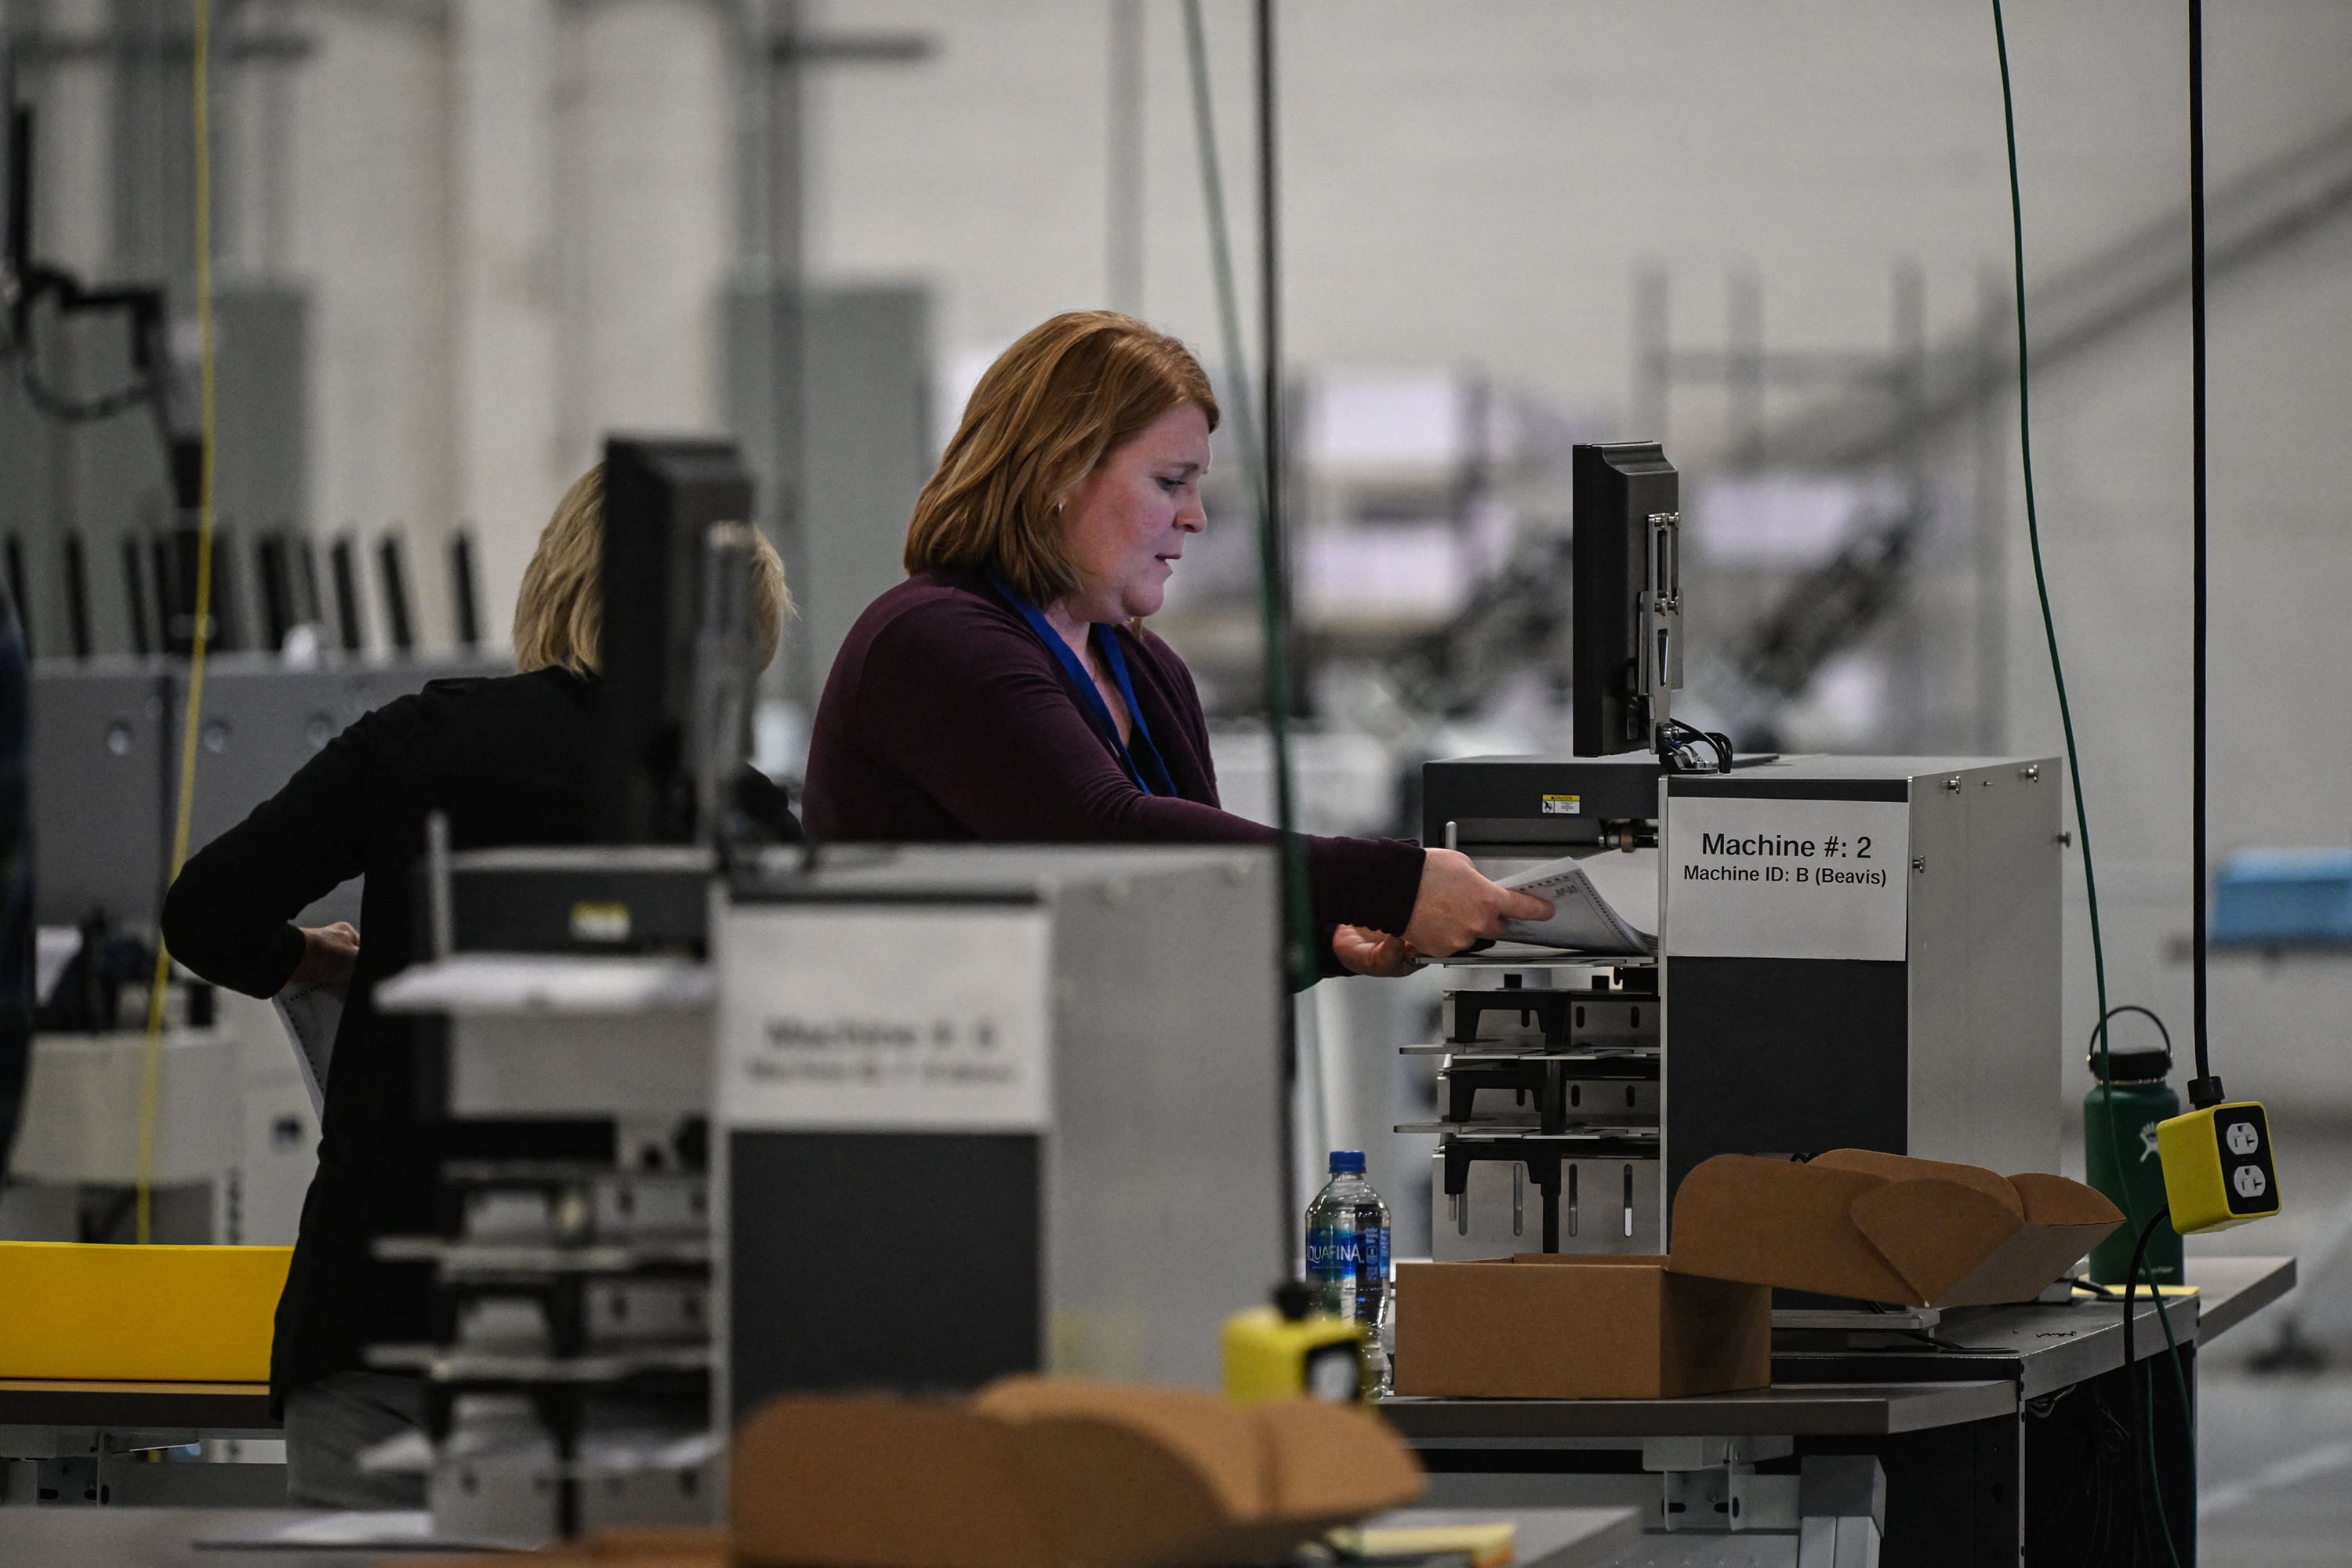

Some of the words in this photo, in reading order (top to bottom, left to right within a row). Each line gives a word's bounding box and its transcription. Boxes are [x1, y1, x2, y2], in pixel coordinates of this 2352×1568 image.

[1702, 833, 1816, 858] Machine
[1824, 836, 1847, 858] #:
[1857, 836, 1871, 858] 2
[1684, 865, 1760, 882] Machine
[1766, 866, 1789, 883] ID:
[1796, 867, 1809, 883] B
[1815, 868, 1886, 887] (Beavis)
[1308, 1243, 1361, 1264] QUAFINA
